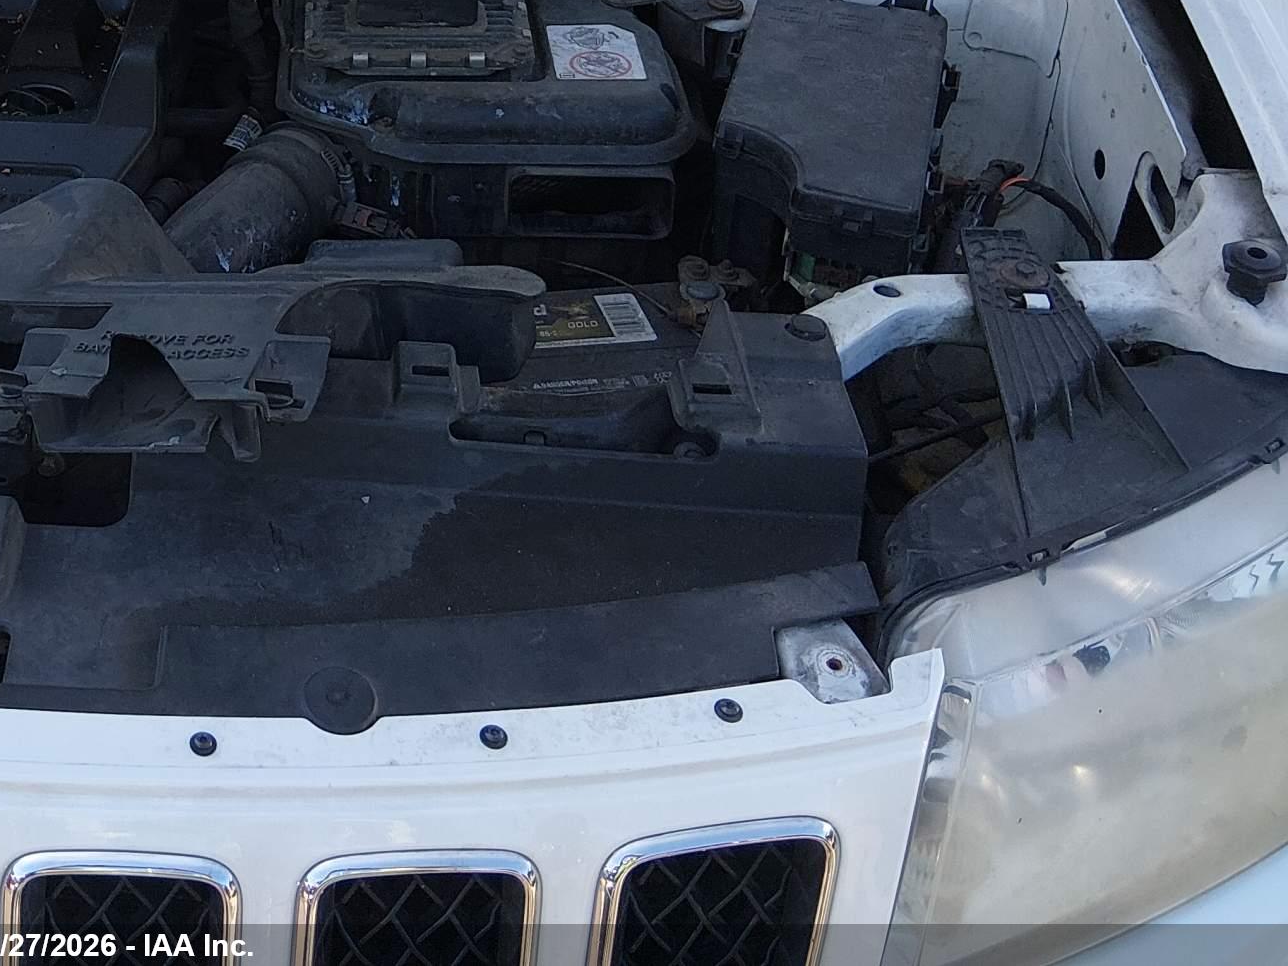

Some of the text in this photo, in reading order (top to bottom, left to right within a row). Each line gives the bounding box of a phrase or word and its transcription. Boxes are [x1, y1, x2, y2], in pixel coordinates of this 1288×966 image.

[567, 320, 599, 329] GOLD
[100, 330, 235, 346] ROVE FOR
[167, 347, 251, 361] ACCESS
